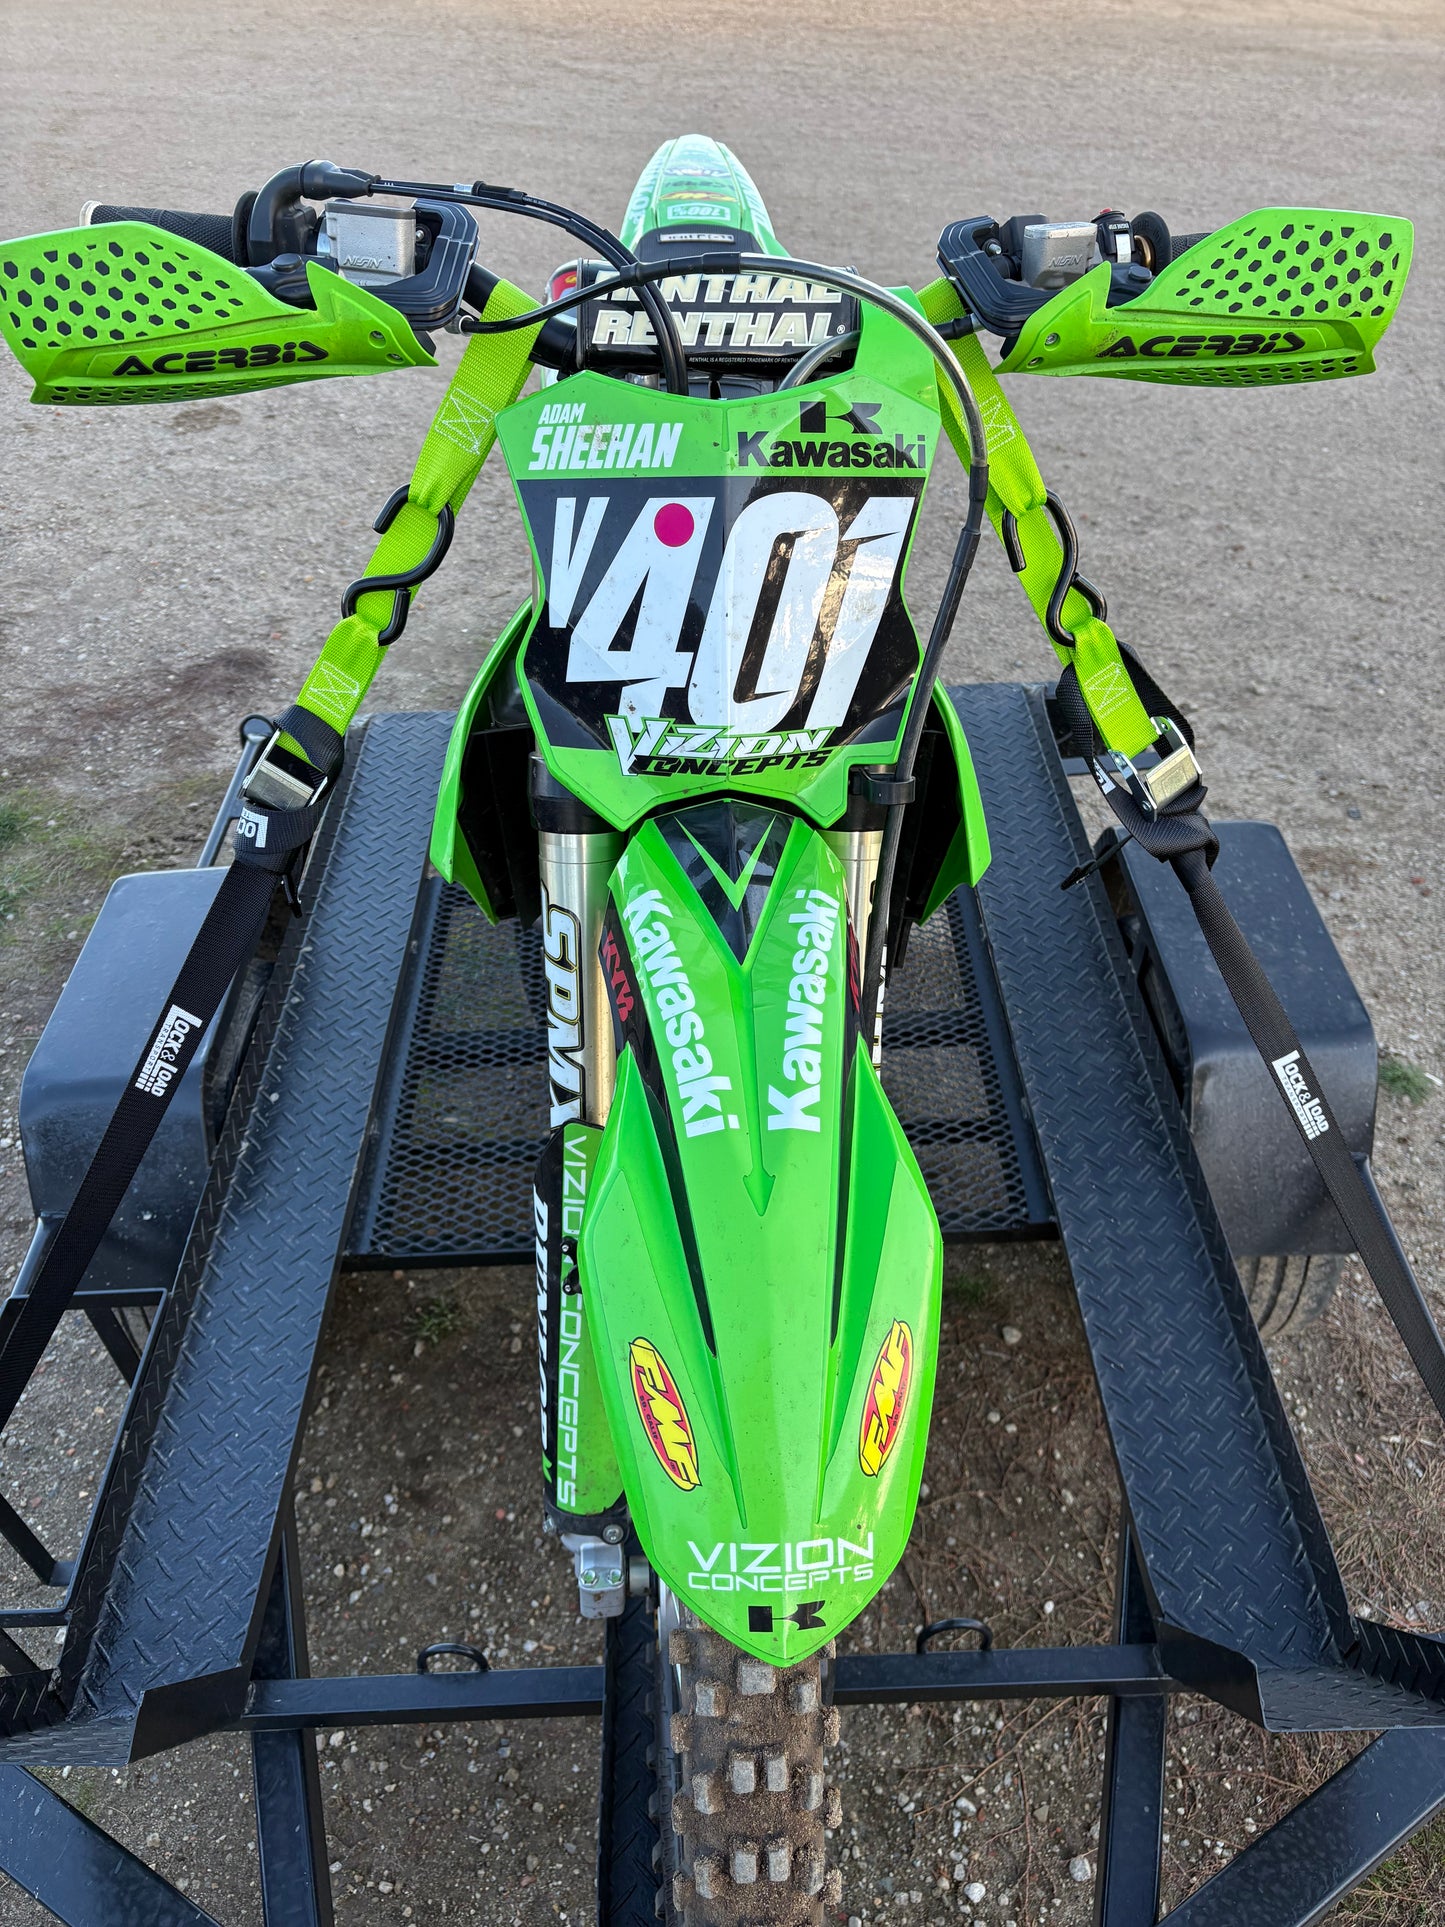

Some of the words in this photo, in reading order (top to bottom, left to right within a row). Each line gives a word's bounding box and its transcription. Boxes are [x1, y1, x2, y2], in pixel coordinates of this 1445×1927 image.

[112, 340, 328, 377] ACERBIS
[1101, 332, 1305, 358] ACERBIS
[538, 403, 586, 425] ADAM
[528, 423, 683, 471] SHEEHAN
[737, 431, 926, 469] Kawasaki
[623, 889, 741, 1139] Kawasaki
[768, 889, 841, 1133] Kawasaki
[687, 1531, 874, 1573] VIZION
[688, 1562, 874, 1593] CONCEPTS
